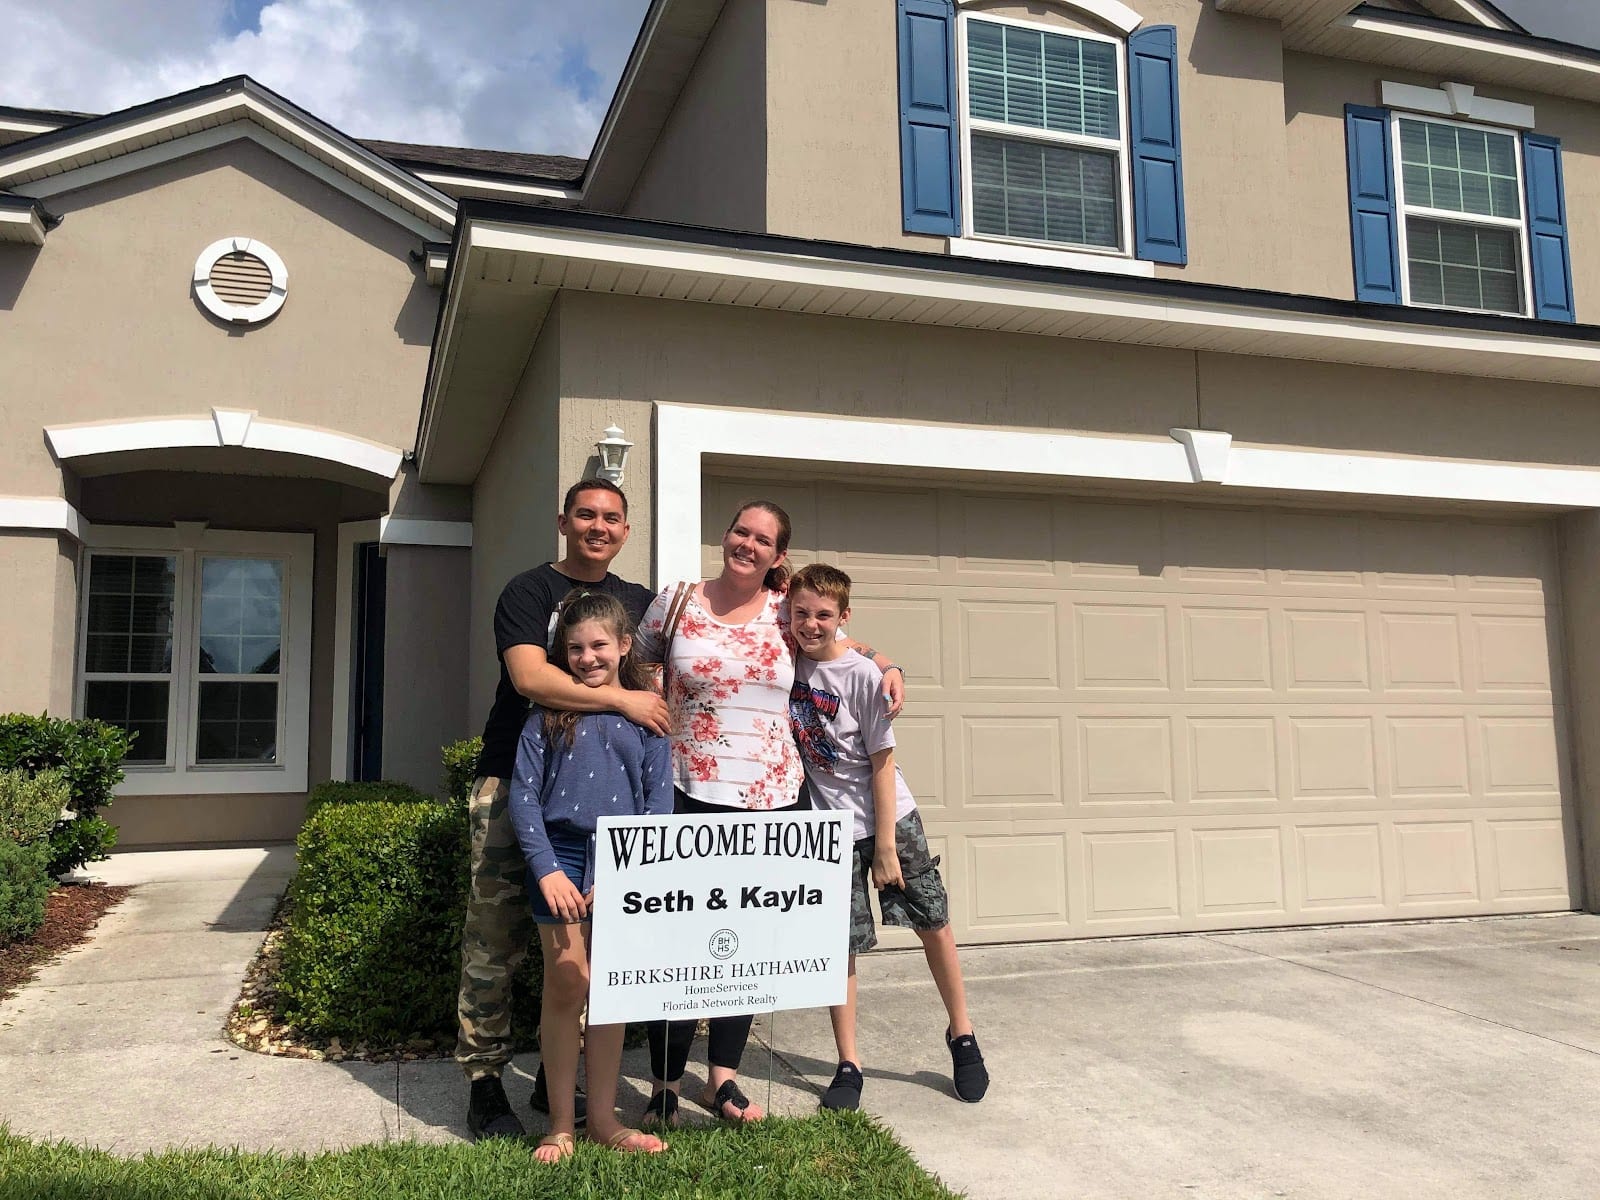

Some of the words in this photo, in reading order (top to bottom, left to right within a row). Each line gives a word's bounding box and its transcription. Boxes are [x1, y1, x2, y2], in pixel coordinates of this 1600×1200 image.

[608, 823, 756, 872] WELCOME
[763, 821, 841, 864] HOME
[623, 890, 693, 914] Seth
[706, 888, 728, 910] &
[741, 884, 822, 912] Kayla
[717, 944, 730, 953] HS
[718, 937, 730, 945] BH
[608, 965, 724, 986] BERKSHIRE
[731, 957, 831, 978] HATHAWAY
[684, 982, 758, 995] HomeServices
[662, 1000, 699, 1011] Florida
[702, 996, 744, 1008] Network
[748, 994, 778, 1006] Realty
